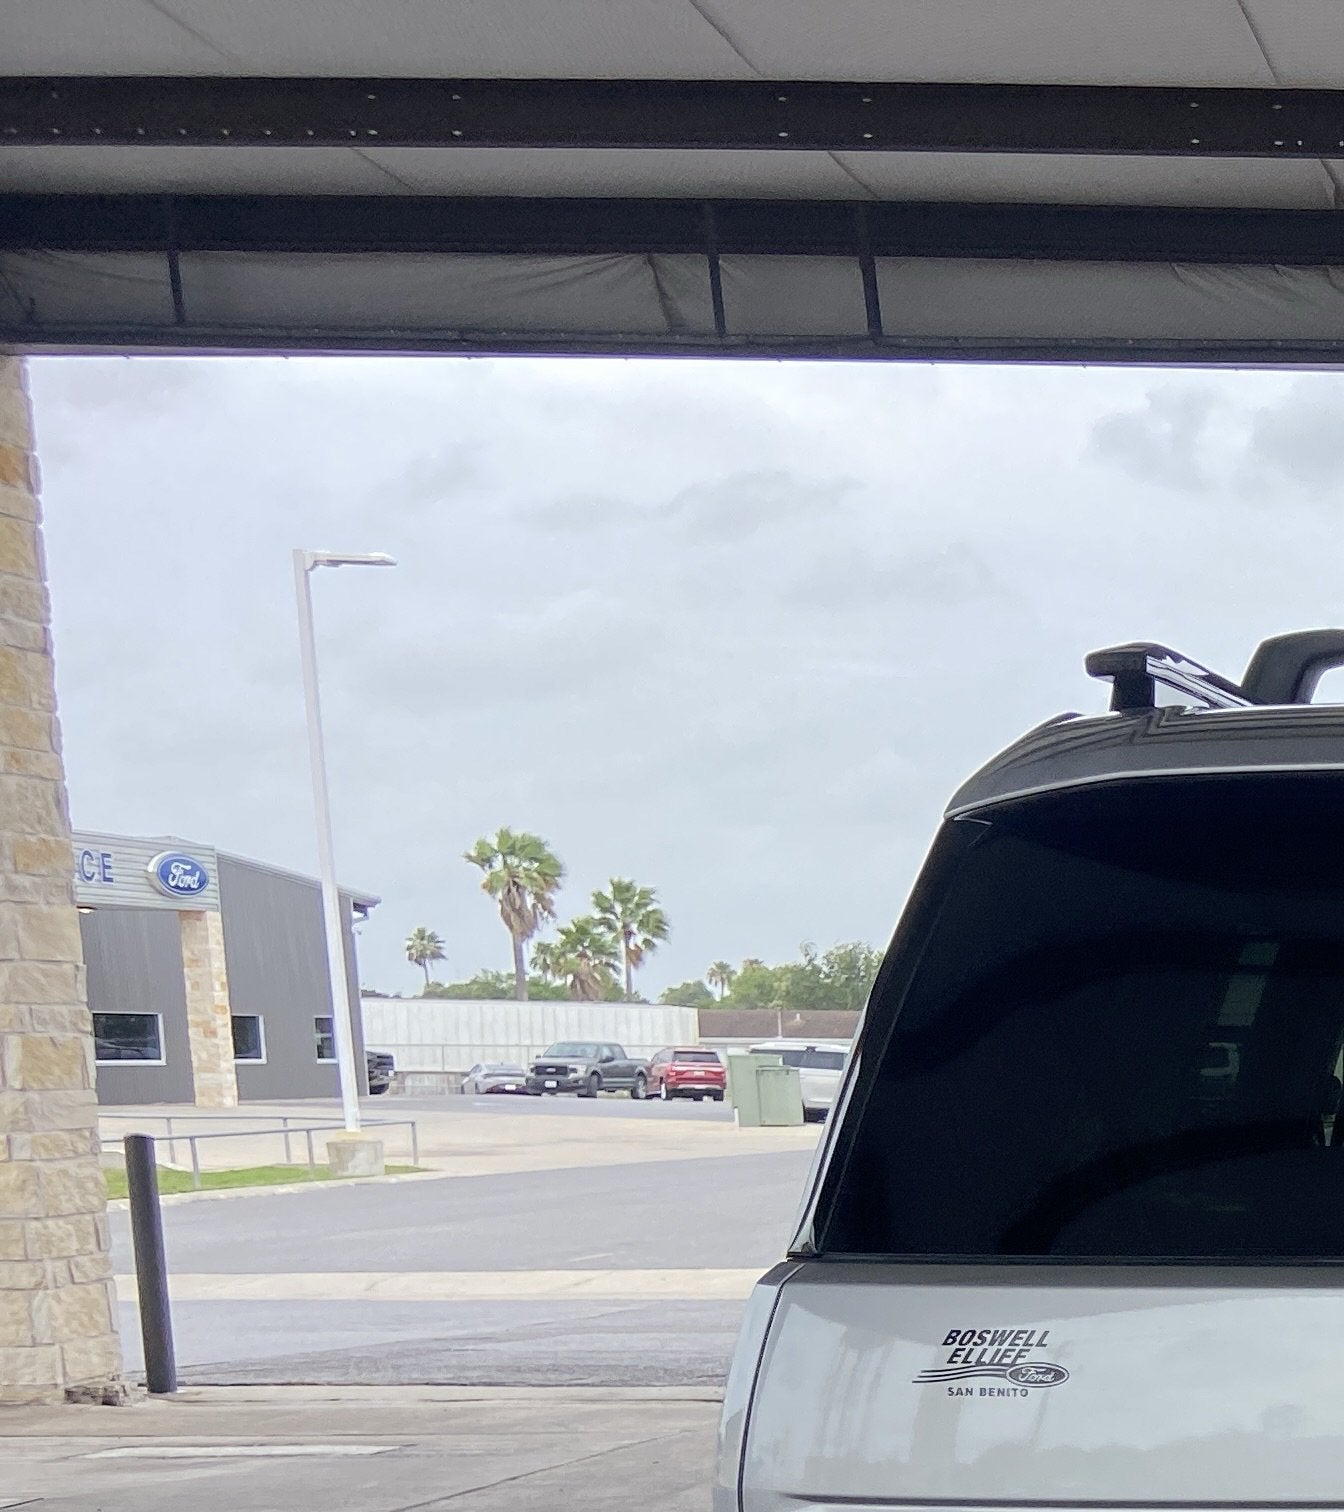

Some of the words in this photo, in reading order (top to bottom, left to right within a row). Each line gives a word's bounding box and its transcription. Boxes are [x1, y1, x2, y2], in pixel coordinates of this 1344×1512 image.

[167, 861, 201, 889] Ford
[942, 1329, 1051, 1348] BOSWELL
[946, 1347, 1031, 1366] ELLIFF
[1017, 1366, 1057, 1383] Ford
[947, 1386, 974, 1397] SAN
[979, 1386, 1029, 1398] BENITO
